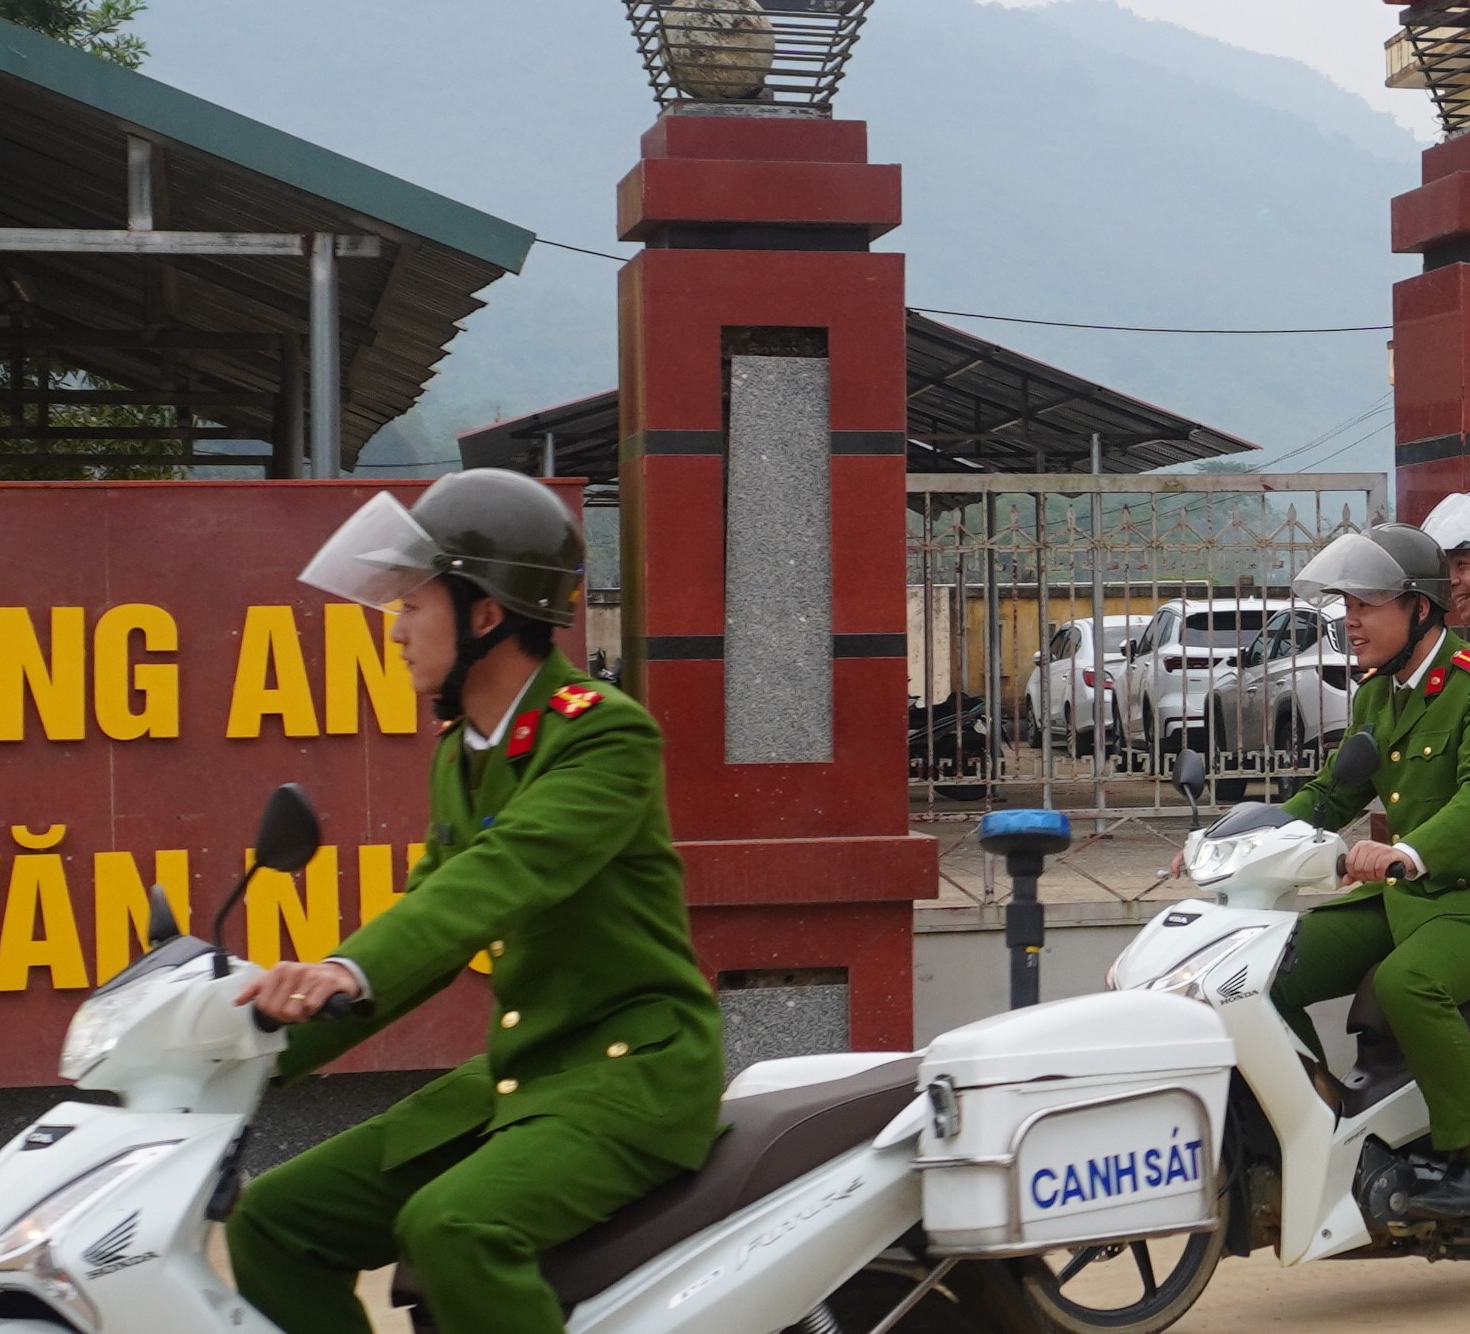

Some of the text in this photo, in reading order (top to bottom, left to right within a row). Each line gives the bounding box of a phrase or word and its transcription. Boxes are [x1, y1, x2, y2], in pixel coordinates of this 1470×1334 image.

[225, 601, 419, 740] AN
[1220, 989, 1260, 1005] HONDA
[1144, 1126, 1203, 1187] SÁT
[84, 1251, 160, 1281] HONDA
